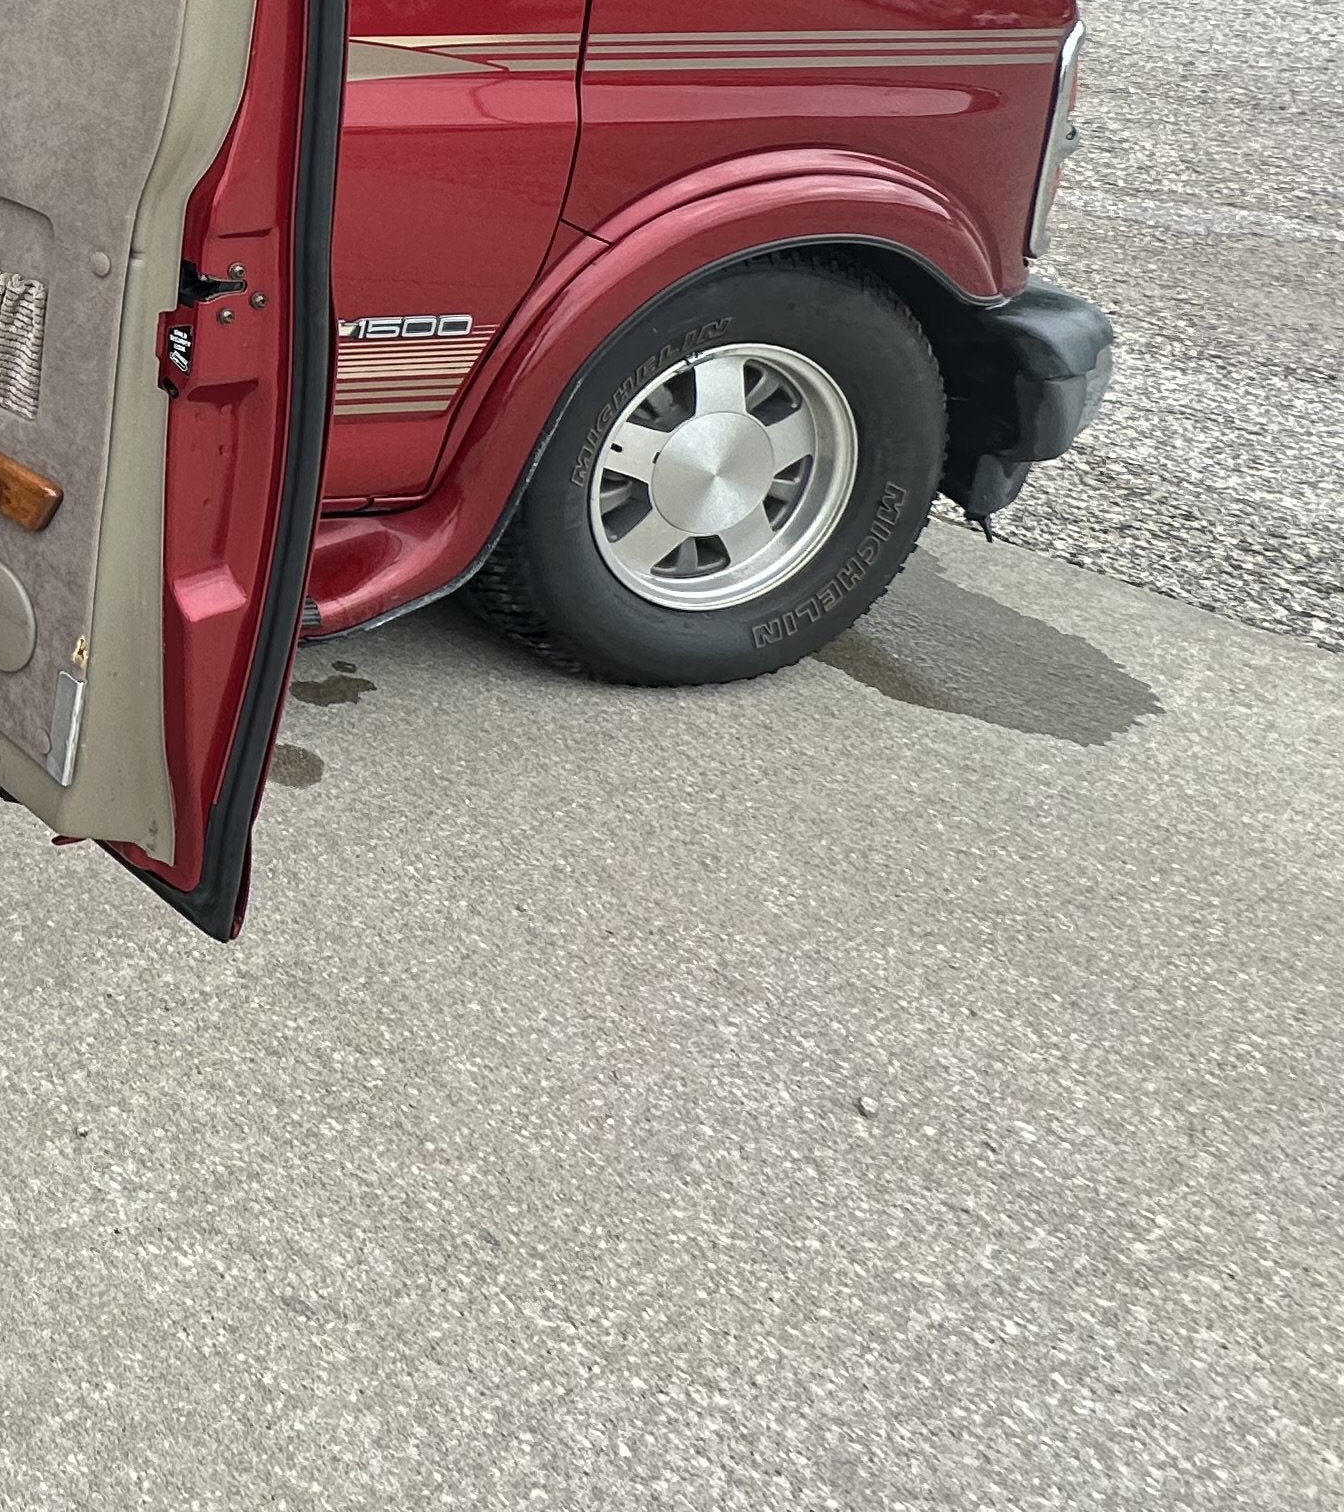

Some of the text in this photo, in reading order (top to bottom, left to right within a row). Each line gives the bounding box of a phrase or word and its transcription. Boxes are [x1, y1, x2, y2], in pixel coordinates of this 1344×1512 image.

[358, 314, 473, 339] 1500
[570, 316, 733, 488] MICHELIN
[753, 482, 906, 649] MICHELIN
